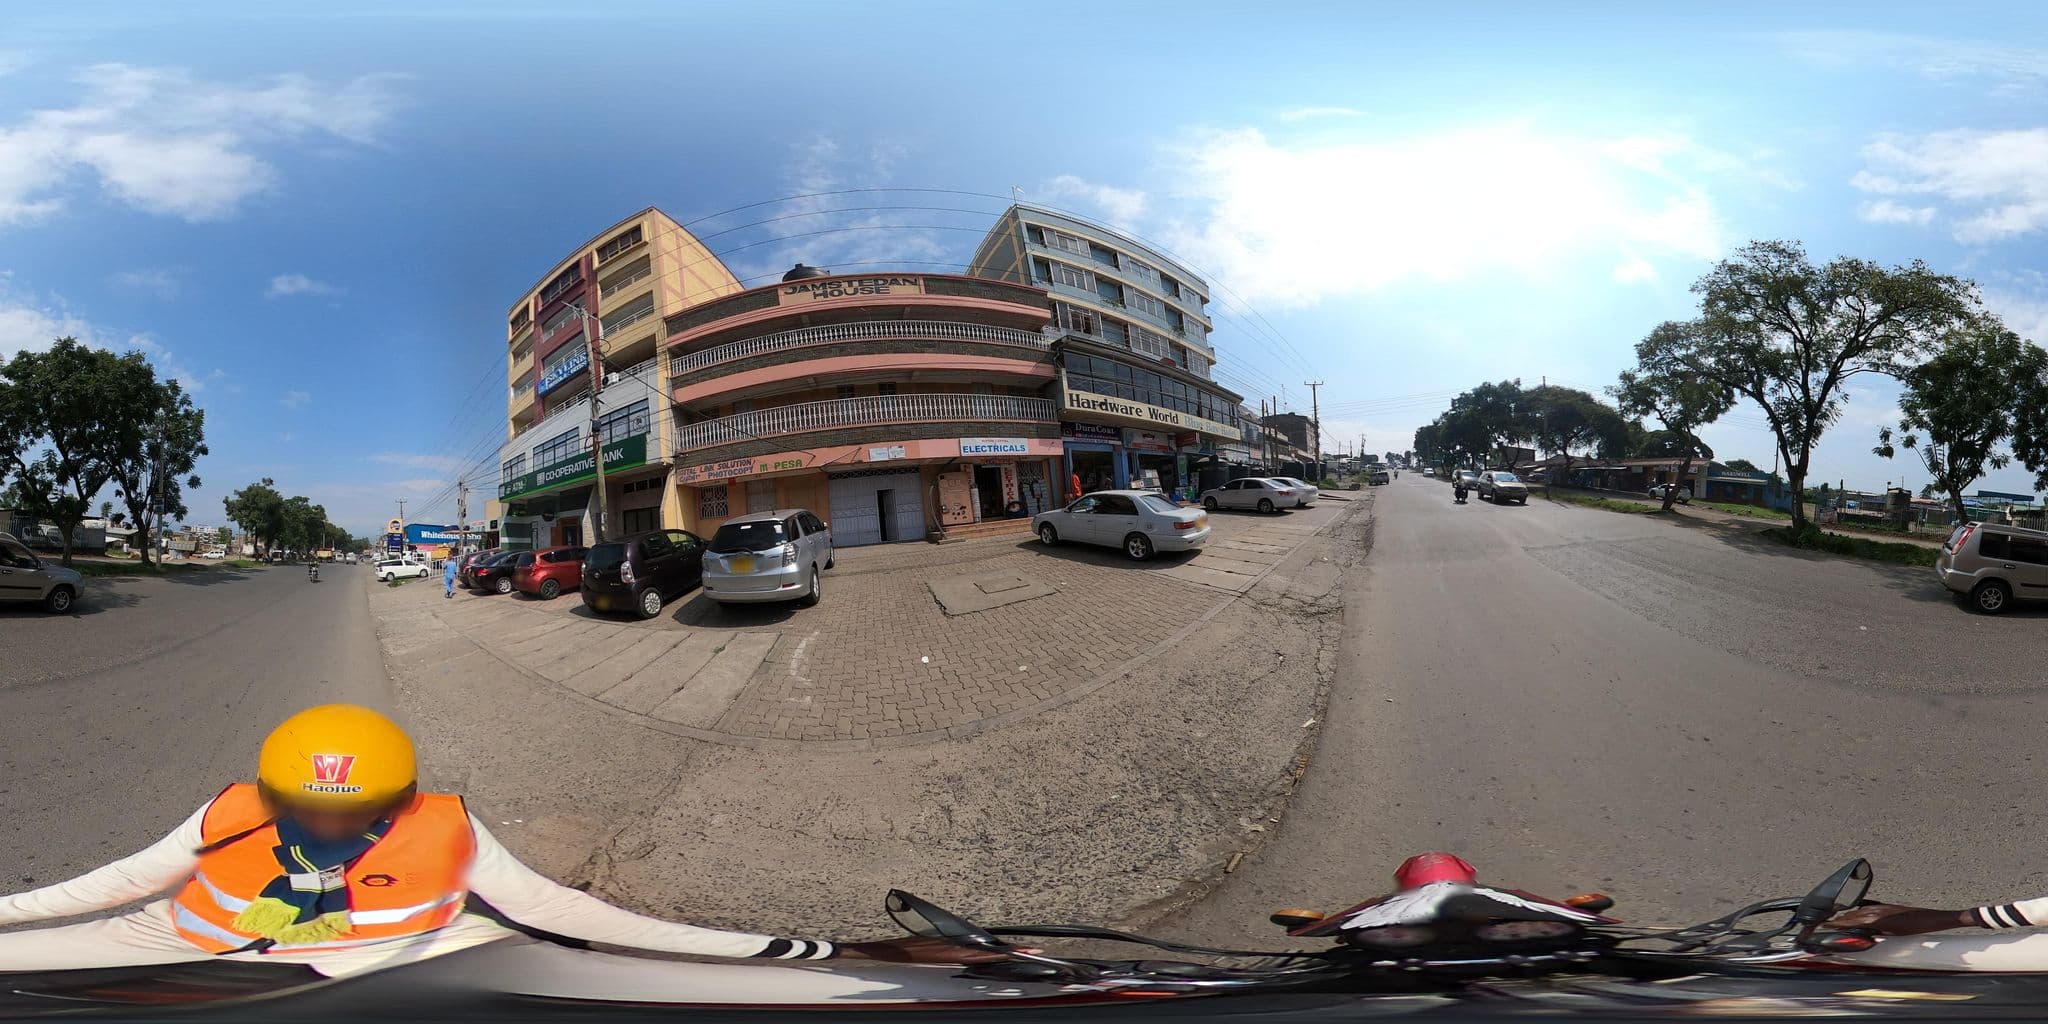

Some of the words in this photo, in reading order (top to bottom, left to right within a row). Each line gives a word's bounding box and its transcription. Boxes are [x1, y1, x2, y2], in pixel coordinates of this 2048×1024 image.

[784, 278, 918, 295] JAMSTEDAN
[813, 286, 891, 300] HOUSE
[1069, 393, 1143, 417] Hardware
[1148, 406, 1179, 425] World
[962, 444, 1026, 453] ELECTRICALS
[545, 457, 595, 480] CO-OPERATIVE
[603, 447, 624, 464] ANK
[774, 459, 803, 470] PESA
[707, 466, 754, 480] PHOTOCOPY
[302, 783, 362, 793] Haojue
